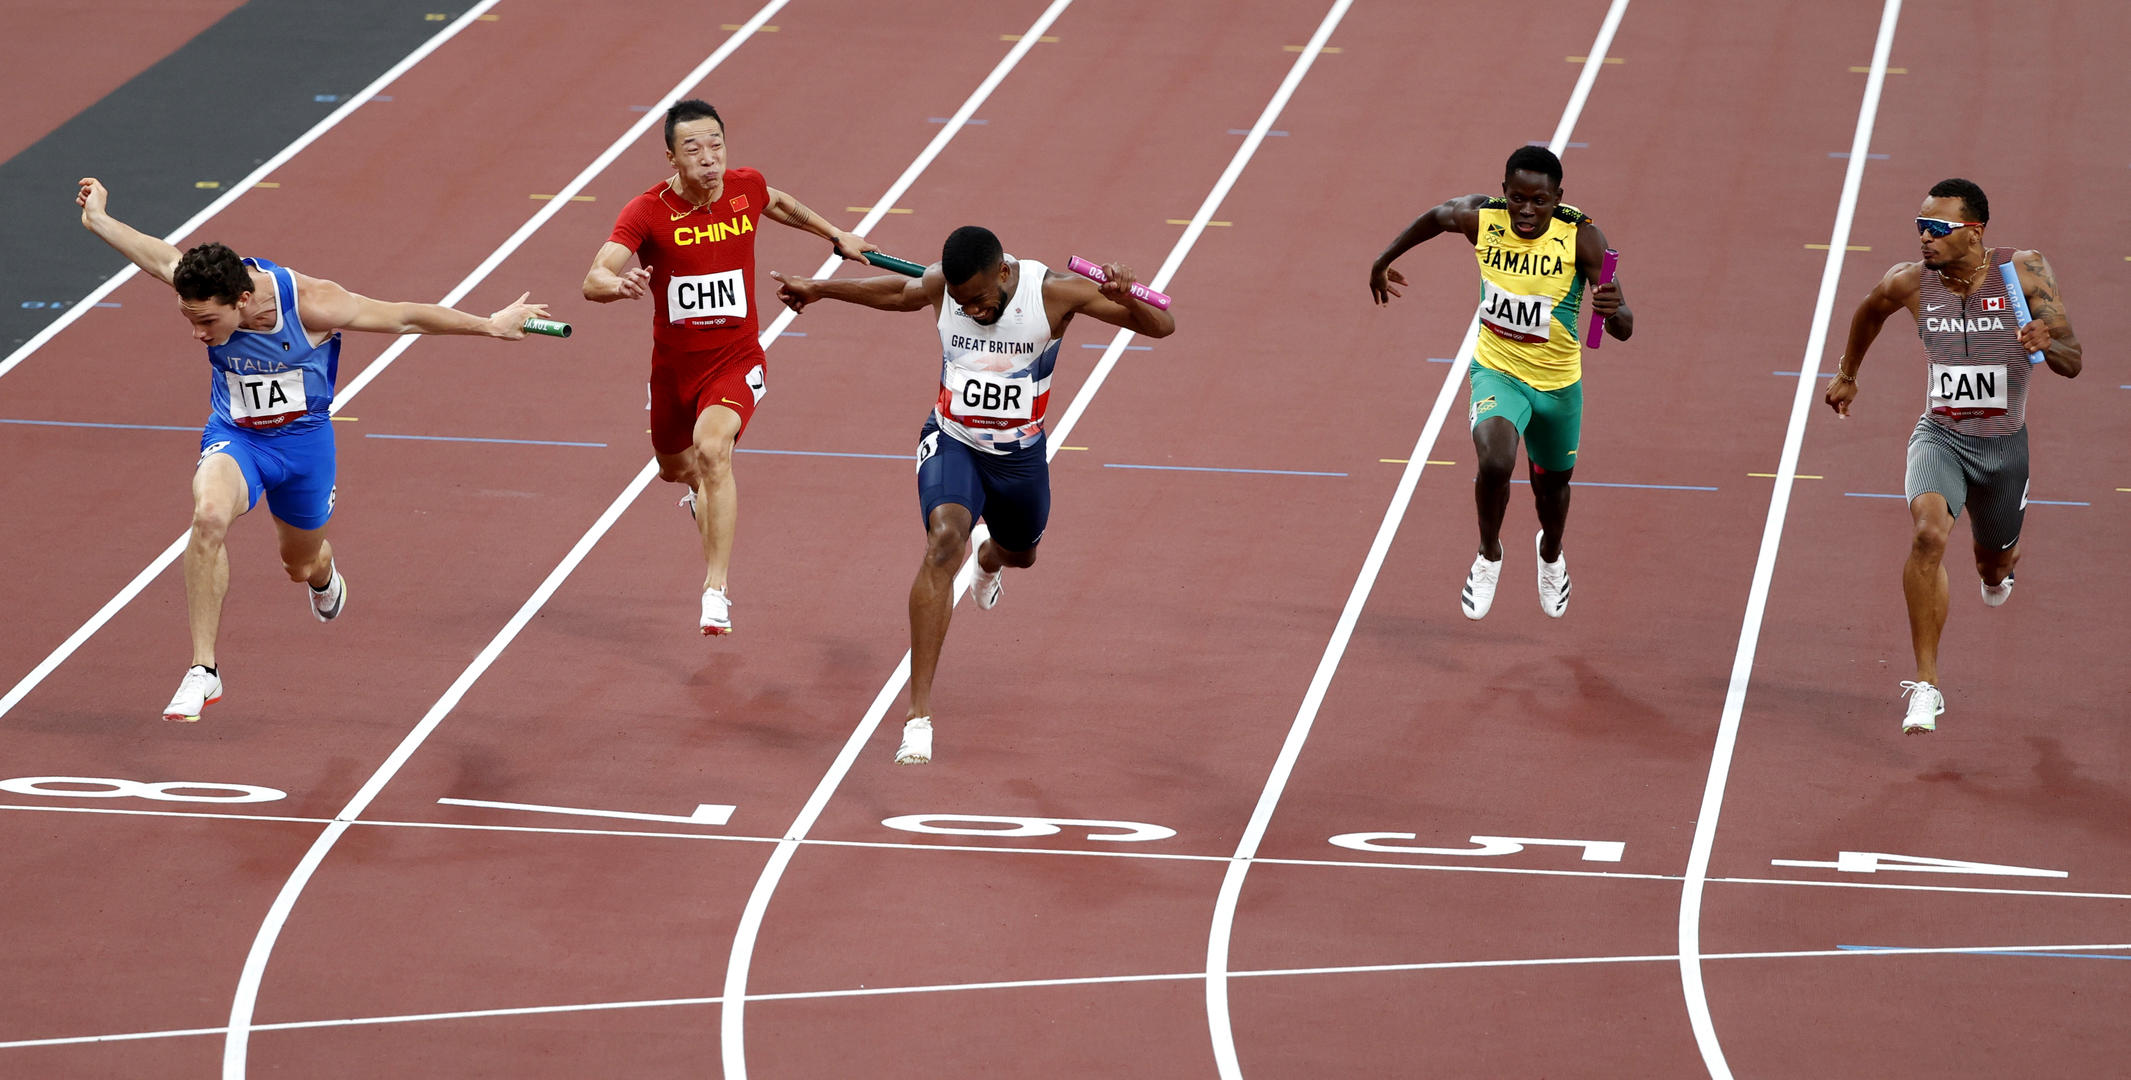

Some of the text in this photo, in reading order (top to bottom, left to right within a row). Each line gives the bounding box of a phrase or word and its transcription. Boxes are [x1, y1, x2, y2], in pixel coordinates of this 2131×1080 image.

[674, 214, 754, 246] CHINA
[1483, 246, 1563, 276] JAMAICA
[678, 278, 736, 310] CHN
[1130, 284, 1151, 300] TOK
[1485, 292, 1542, 327] JAM
[1926, 317, 2005, 333] CANADA
[951, 334, 1034, 355] GREAT BRITAIN
[227, 356, 289, 373] ITALIA
[239, 379, 288, 410] ITA
[963, 378, 1022, 411] GBR
[1940, 371, 1996, 401] CAN
[0, 776, 286, 805] 8
[437, 797, 737, 826] 7
[881, 814, 1177, 842] 6
[1328, 832, 1625, 862] 5
[1771, 851, 2069, 878] 4
